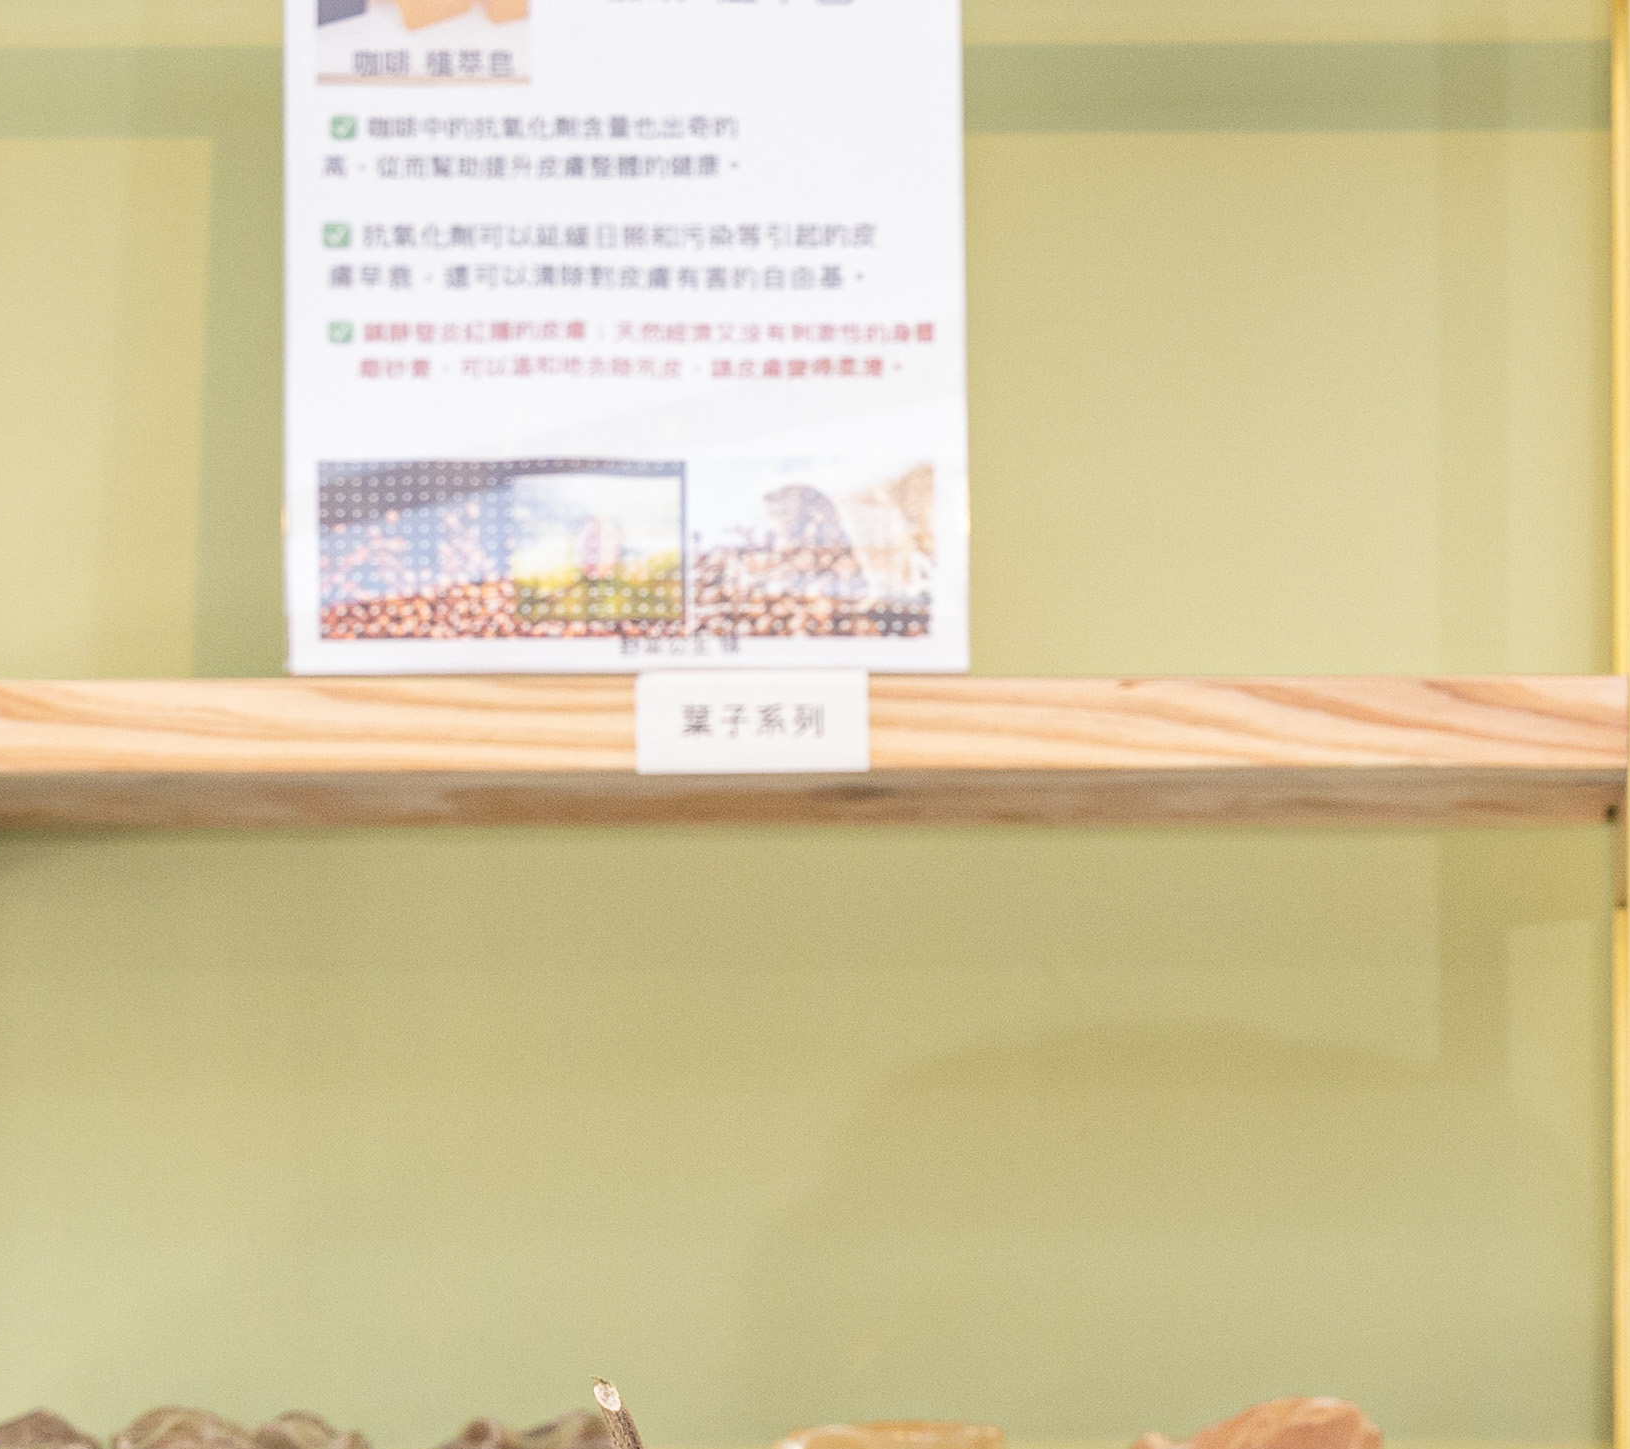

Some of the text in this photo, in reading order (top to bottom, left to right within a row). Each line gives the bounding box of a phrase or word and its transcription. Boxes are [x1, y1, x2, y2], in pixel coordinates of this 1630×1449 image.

[353, 50, 411, 77] 咖啡
[681, 703, 825, 739] 葉子系列
